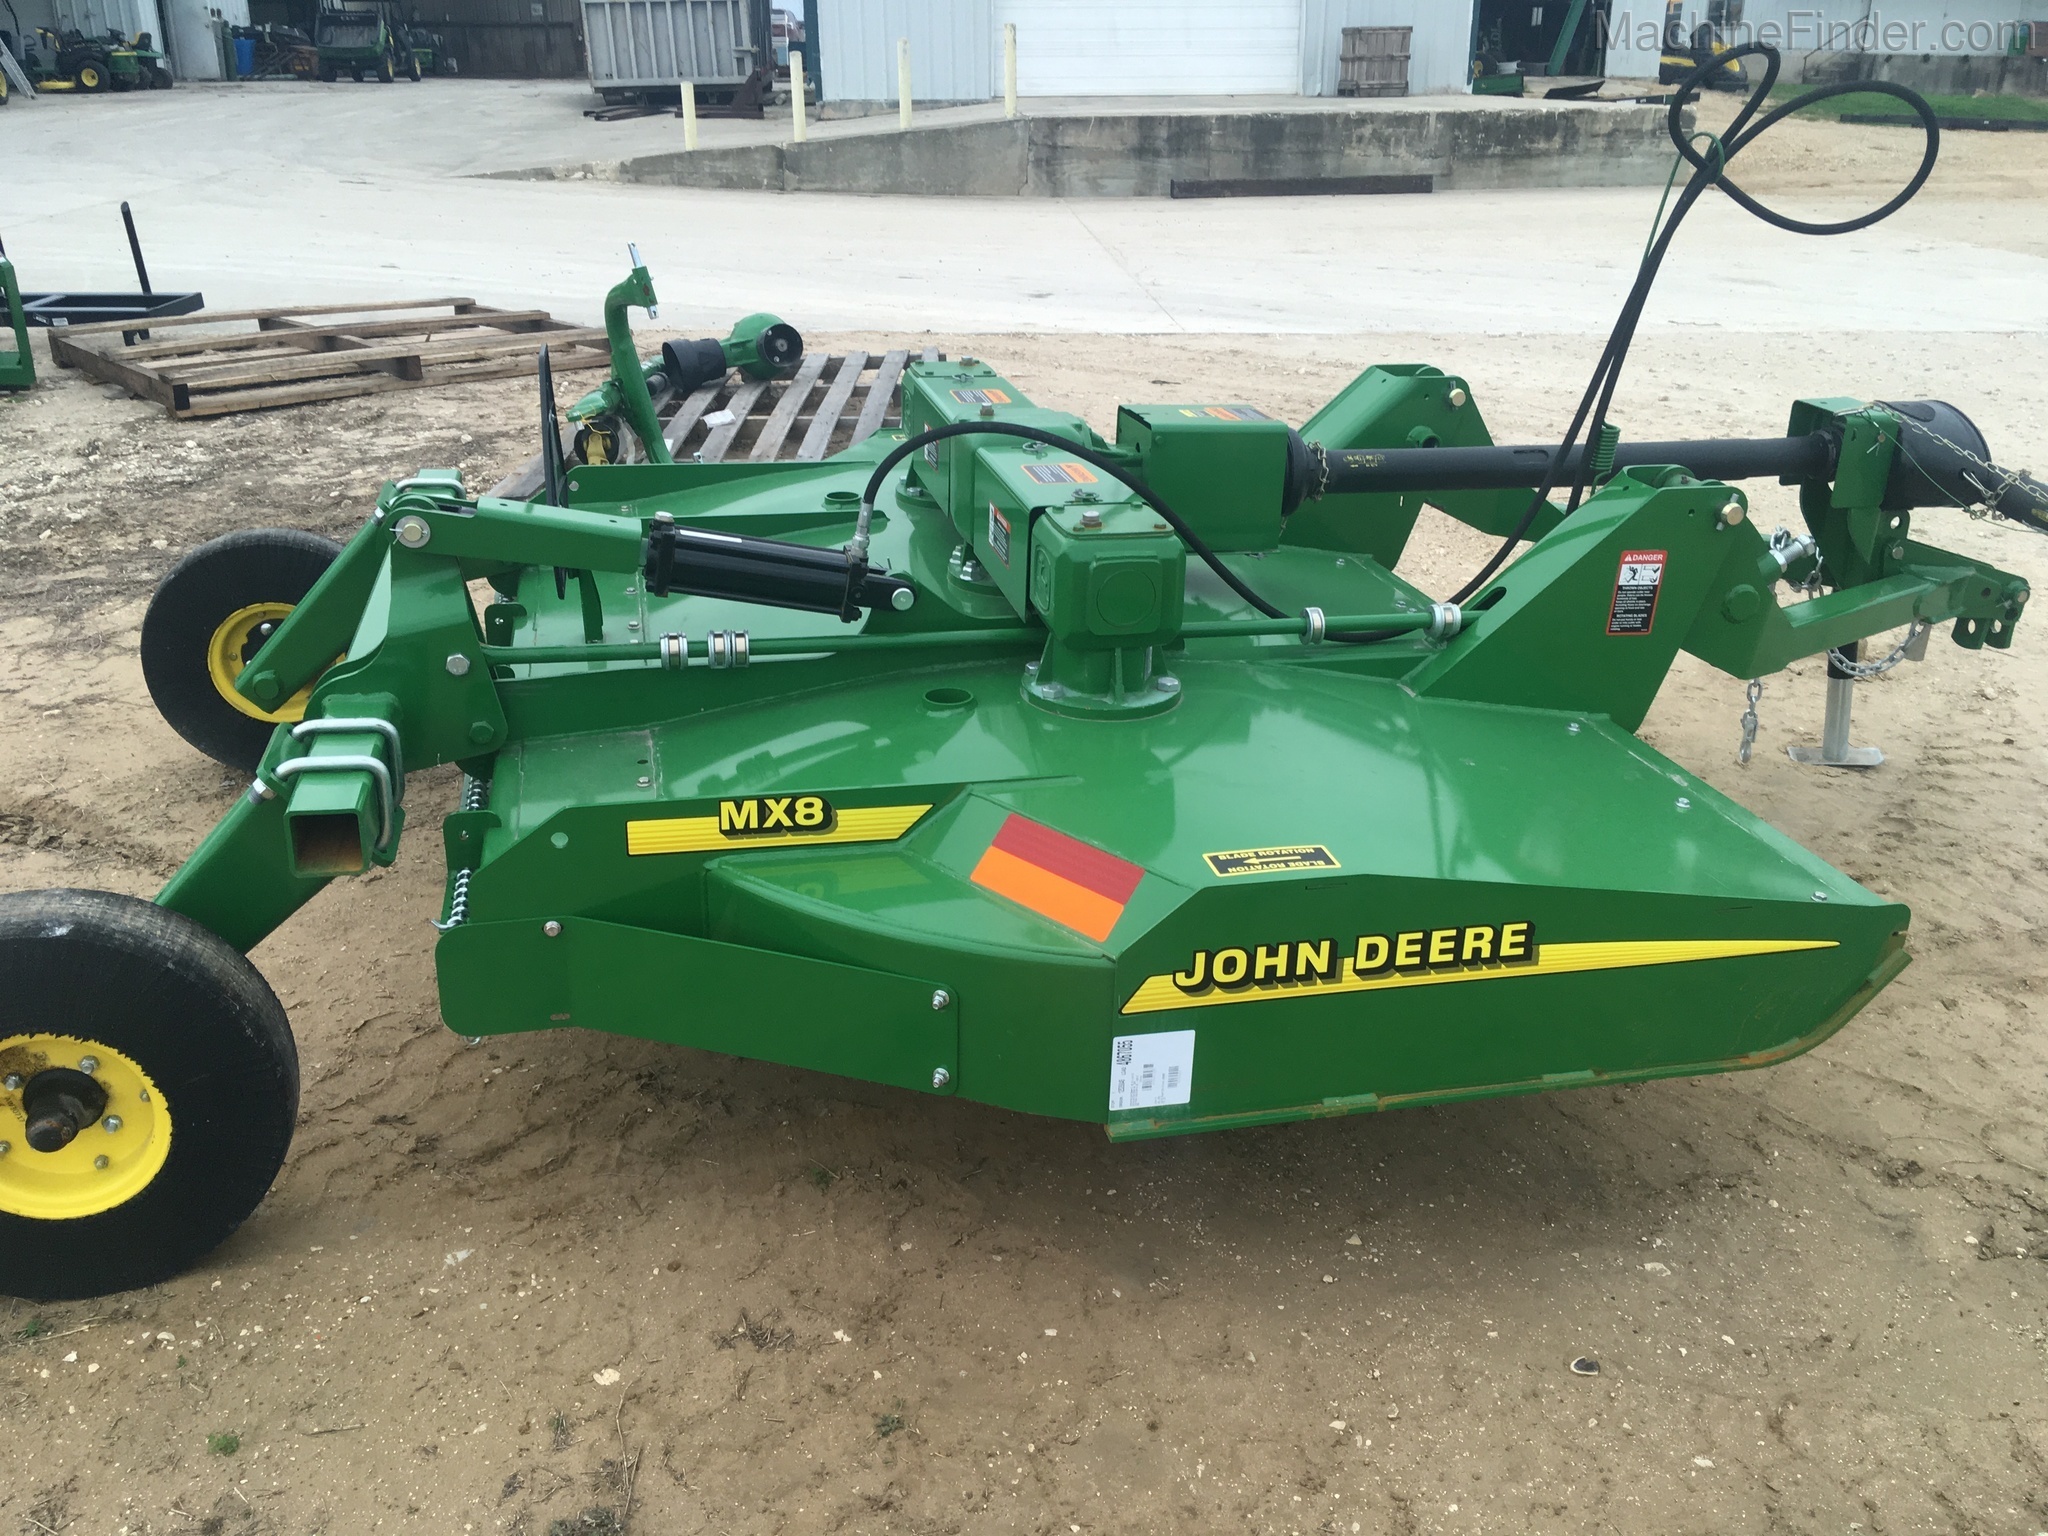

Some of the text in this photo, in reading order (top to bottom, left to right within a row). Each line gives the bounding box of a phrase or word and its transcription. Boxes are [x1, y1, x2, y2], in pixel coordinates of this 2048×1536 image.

[1632, 554, 1663, 562] DANGER
[719, 795, 836, 838] MX8
[1218, 848, 1315, 861] BLADE ROTATION
[1172, 920, 1536, 991] JOHN DEERE
